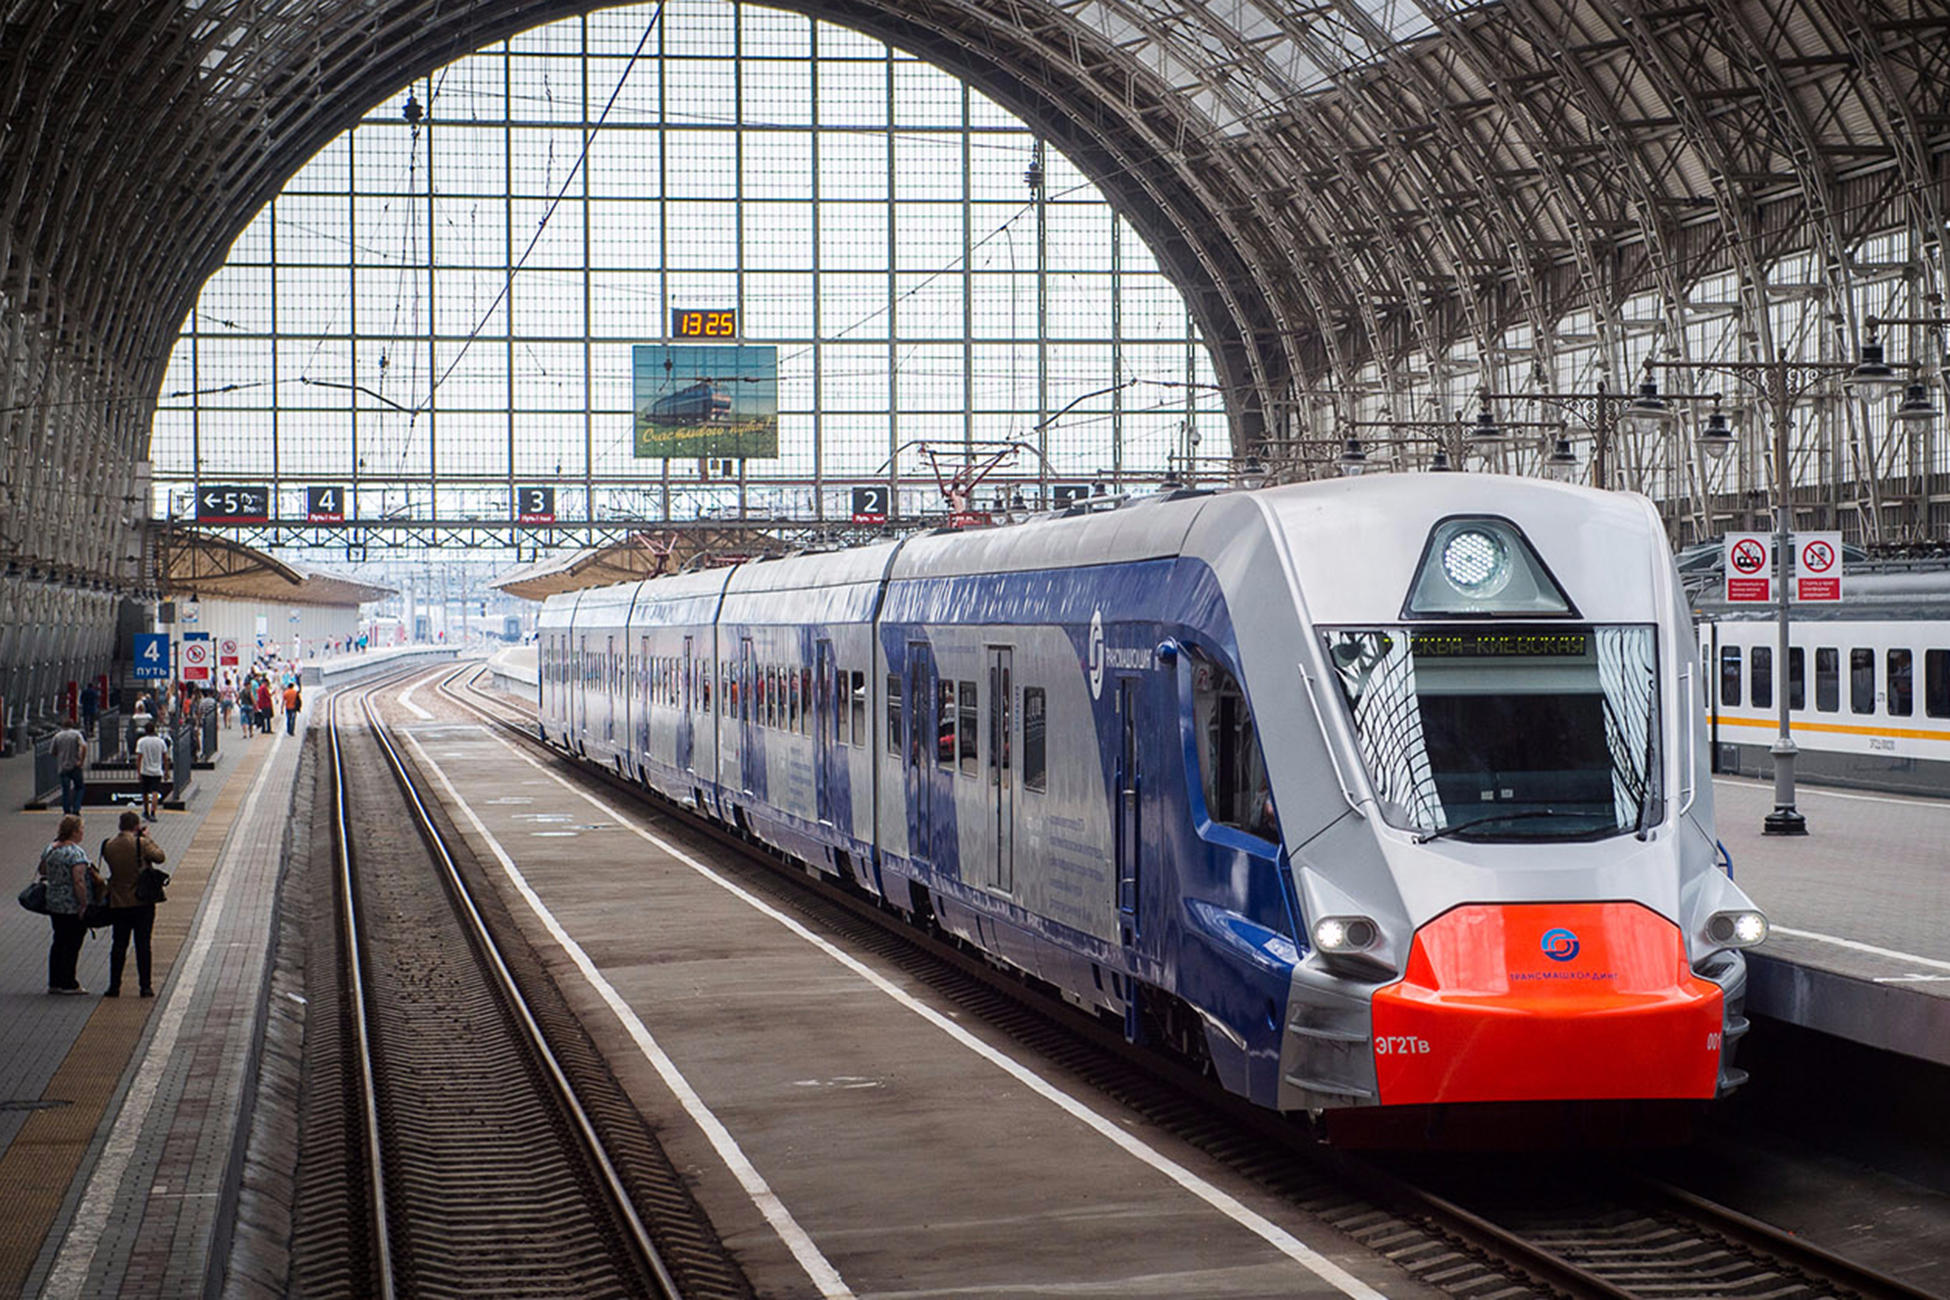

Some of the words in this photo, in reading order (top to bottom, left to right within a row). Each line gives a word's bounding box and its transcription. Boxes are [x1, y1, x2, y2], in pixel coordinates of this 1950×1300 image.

[224, 492, 238, 513] 5
[318, 489, 335, 512] 4
[530, 490, 545, 513] 3
[863, 490, 879, 512] 2
[143, 640, 160, 662] 4
[1510, 971, 1617, 981] ТРАНСМАШХОЛДИНГ
[1375, 1035, 1431, 1055] ЭГ2Тв
